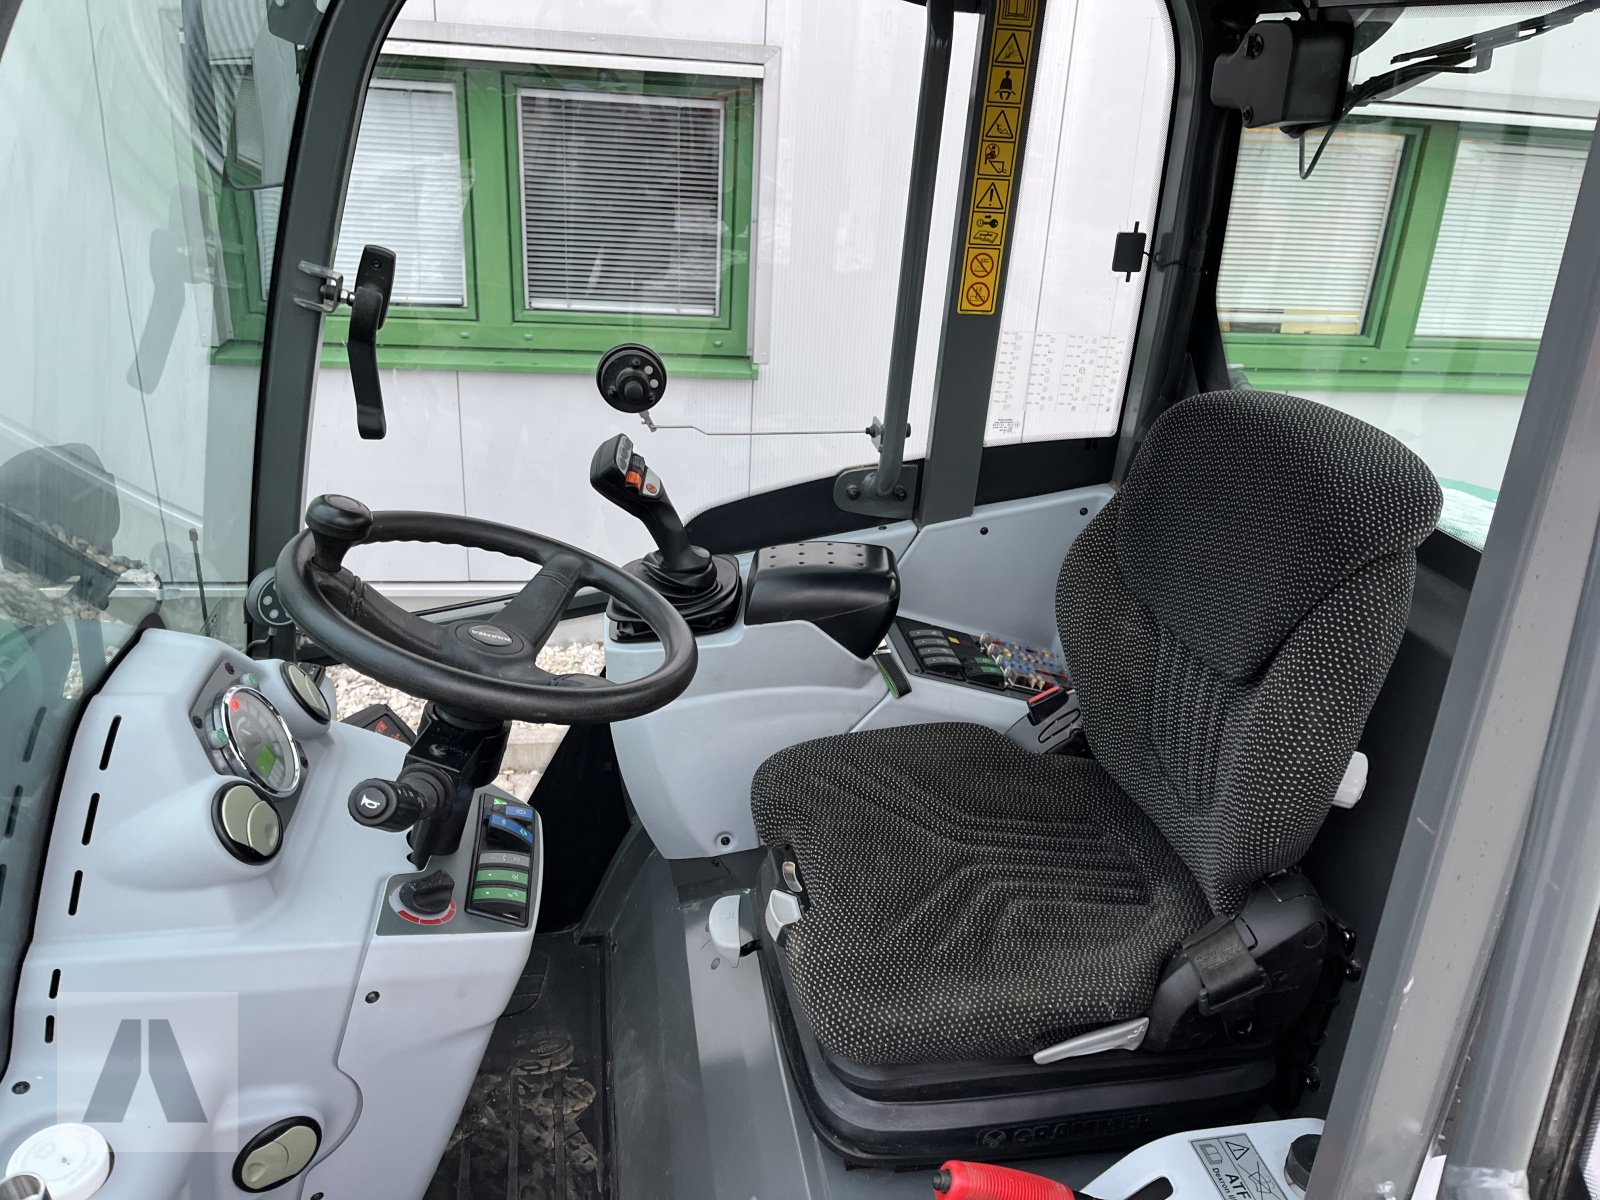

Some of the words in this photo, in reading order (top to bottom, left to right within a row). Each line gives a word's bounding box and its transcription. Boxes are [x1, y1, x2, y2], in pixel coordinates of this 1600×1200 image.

[1013, 1113, 1155, 1143] GRAMMER
[1211, 1167, 1230, 1193] Dexron
[1225, 1173, 1251, 1199] ATF
